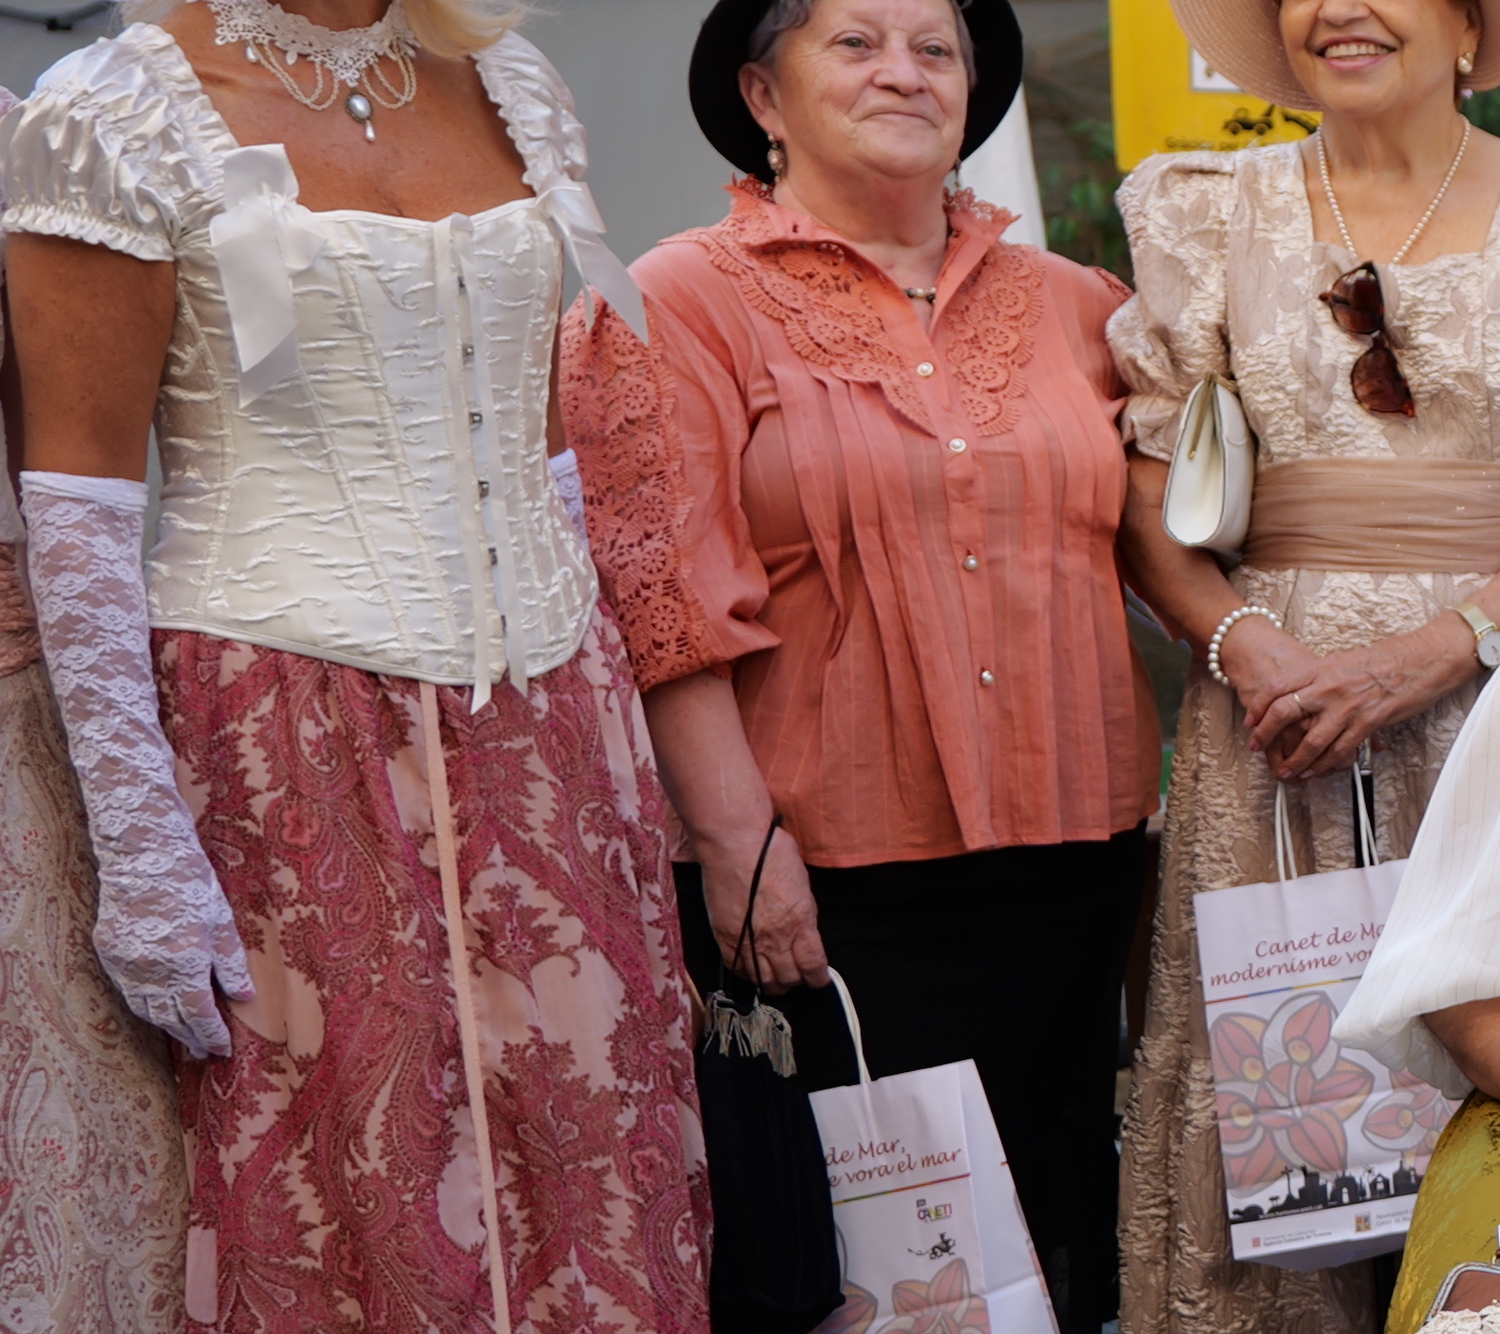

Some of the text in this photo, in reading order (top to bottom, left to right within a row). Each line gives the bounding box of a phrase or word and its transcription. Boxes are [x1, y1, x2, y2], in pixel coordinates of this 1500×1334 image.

[1255, 932, 1322, 958] Canet
[1326, 927, 1357, 945] de
[1210, 954, 1343, 986] modernisme
[826, 1139, 906, 1166] de Mar,
[845, 1164, 895, 1184] vora
[897, 1154, 917, 1173] el
[921, 1148, 962, 1168] mar
